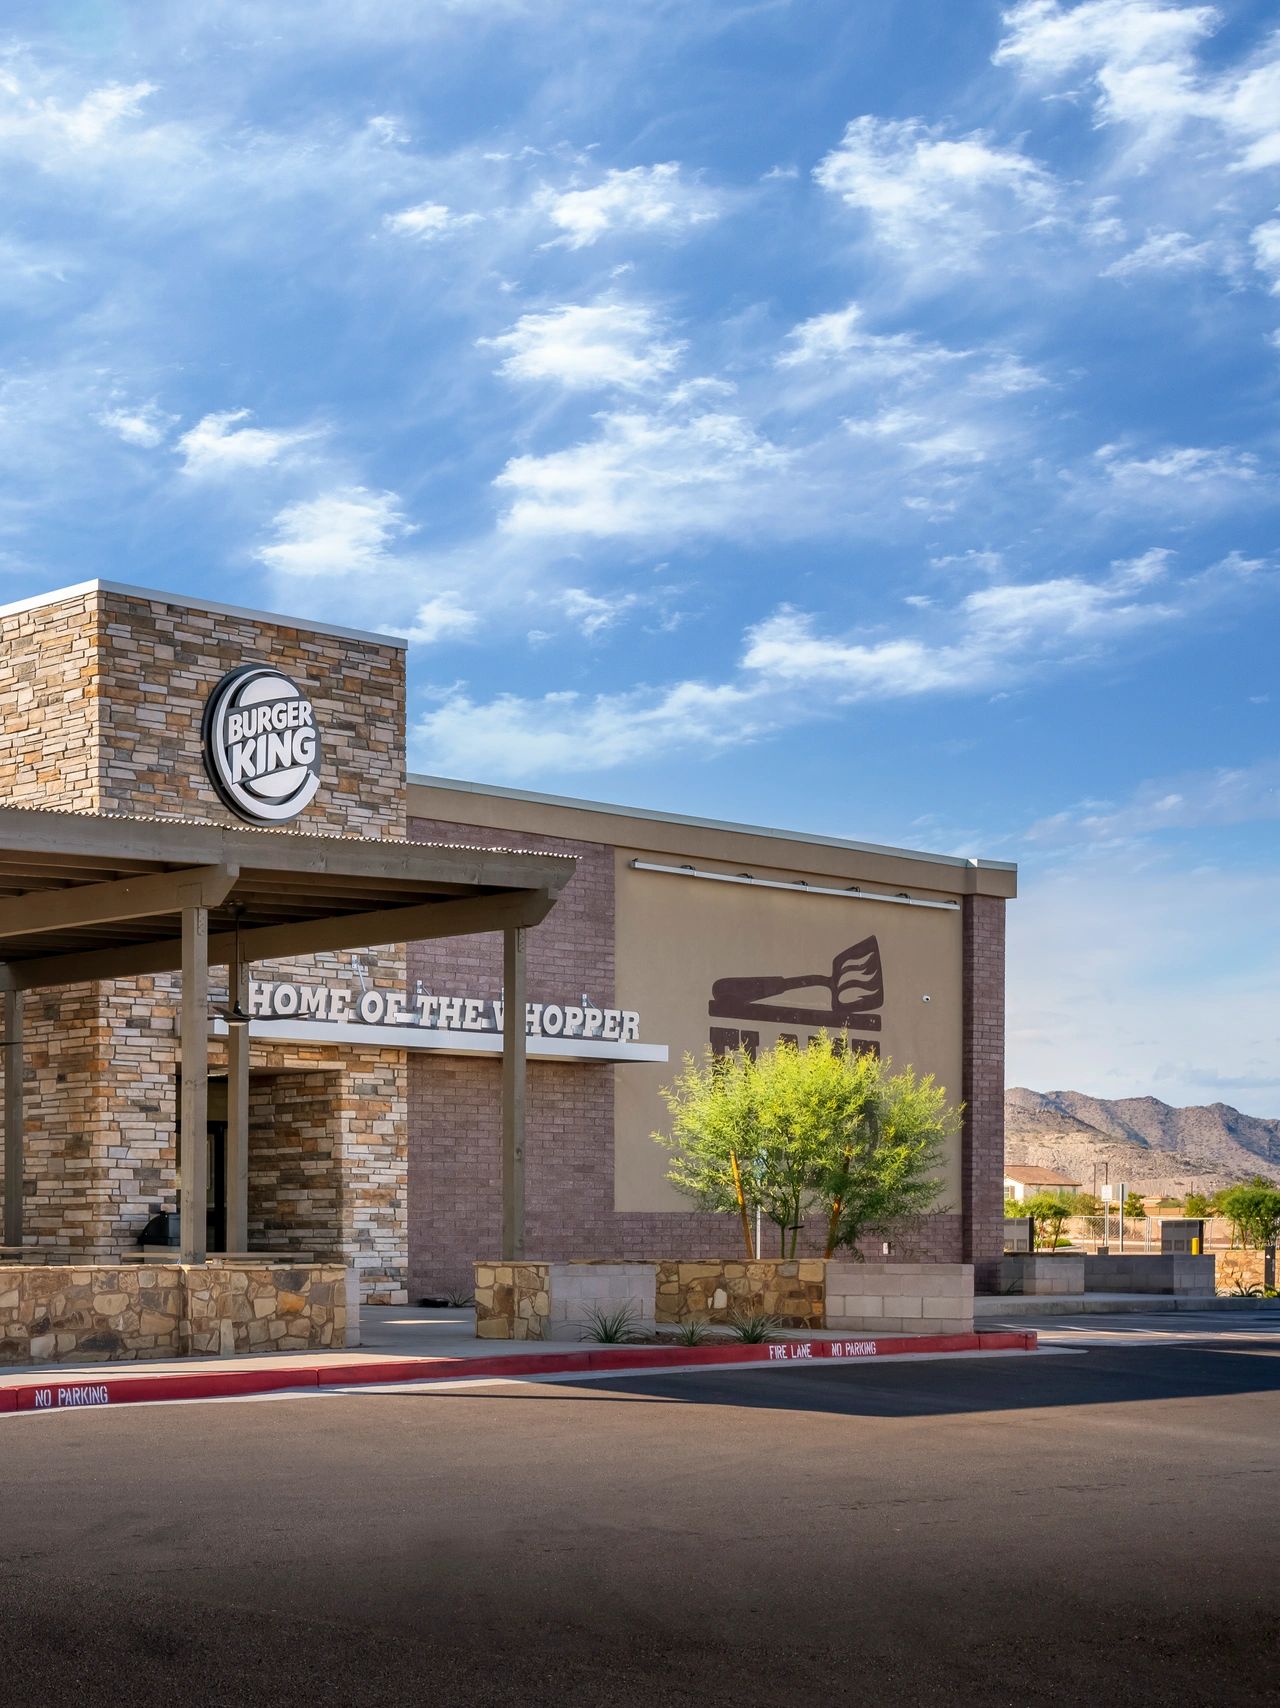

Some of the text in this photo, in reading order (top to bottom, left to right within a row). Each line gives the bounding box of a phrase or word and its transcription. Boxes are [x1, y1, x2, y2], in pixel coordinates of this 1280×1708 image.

[228, 701, 313, 745] BURGER
[232, 727, 316, 784] KING
[249, 982, 352, 1020] HOME
[357, 990, 407, 1025] OF
[417, 994, 484, 1031] THE
[769, 1341, 877, 1360] FIRE LANE NO PARKING
[35, 1389, 52, 1408] NO
[57, 1385, 109, 1407] PARKING
